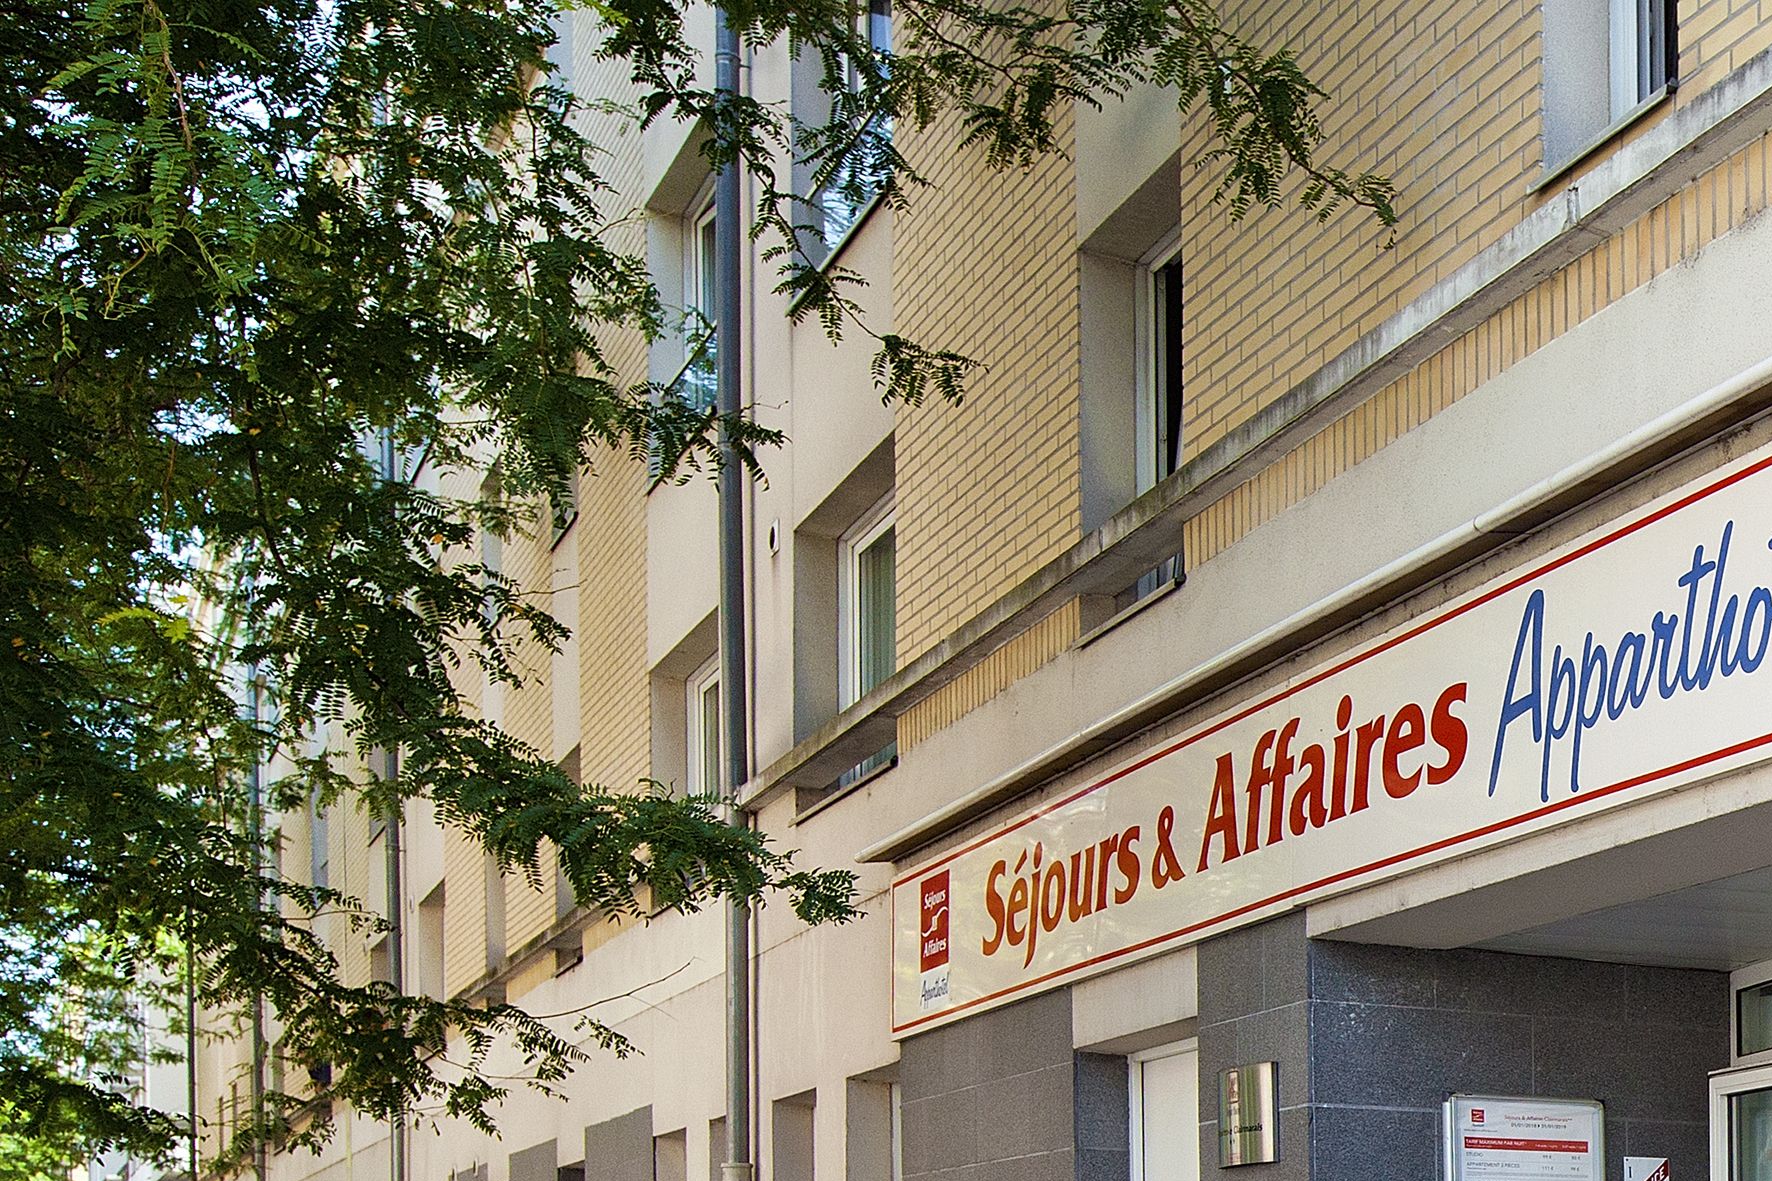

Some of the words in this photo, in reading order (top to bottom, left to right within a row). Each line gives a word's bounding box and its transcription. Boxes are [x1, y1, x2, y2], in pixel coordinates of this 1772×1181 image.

[982, 825, 1140, 970] Séjours
[1151, 805, 1187, 889] &
[1196, 682, 1469, 873] Affaires
